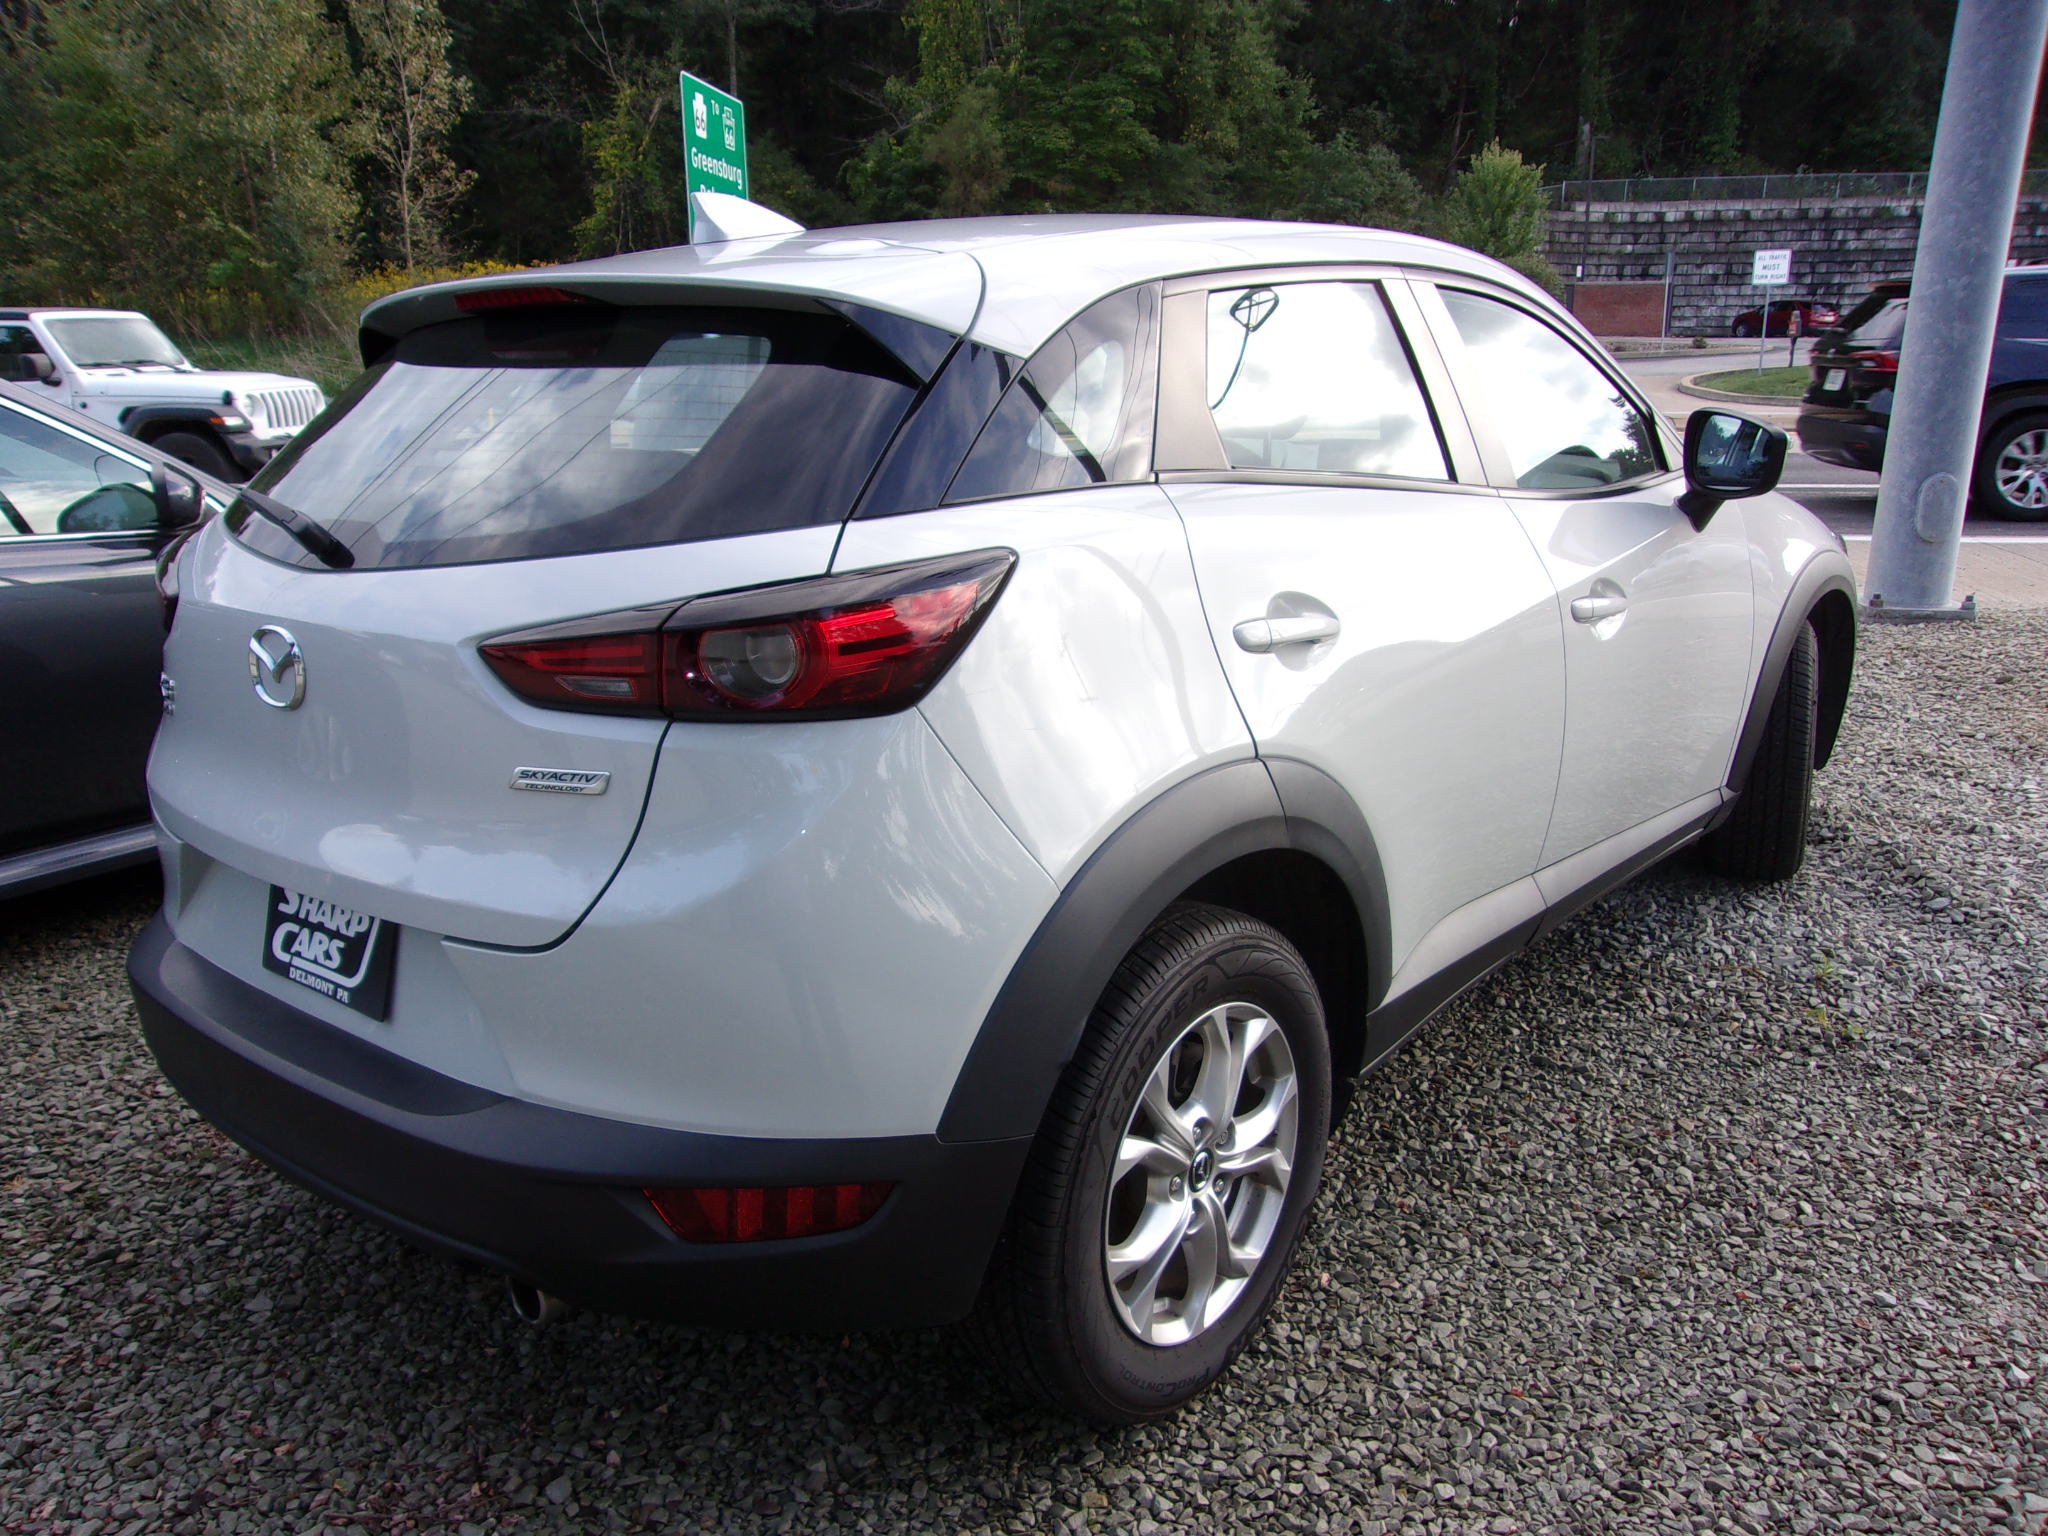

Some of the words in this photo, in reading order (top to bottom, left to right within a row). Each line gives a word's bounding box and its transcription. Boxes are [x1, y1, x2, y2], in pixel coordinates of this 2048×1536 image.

[696, 108, 705, 131] 66
[725, 127, 734, 146] 66
[691, 146, 742, 190] Greensburg
[518, 769, 598, 783] SKYACTIV
[524, 782, 586, 793] TECHNOLOGY
[277, 887, 370, 938] SHARP
[271, 921, 345, 970] CARS
[288, 966, 335, 997] DELMONT
[336, 988, 349, 1003] PA
[1110, 973, 1209, 1131] COOPER
